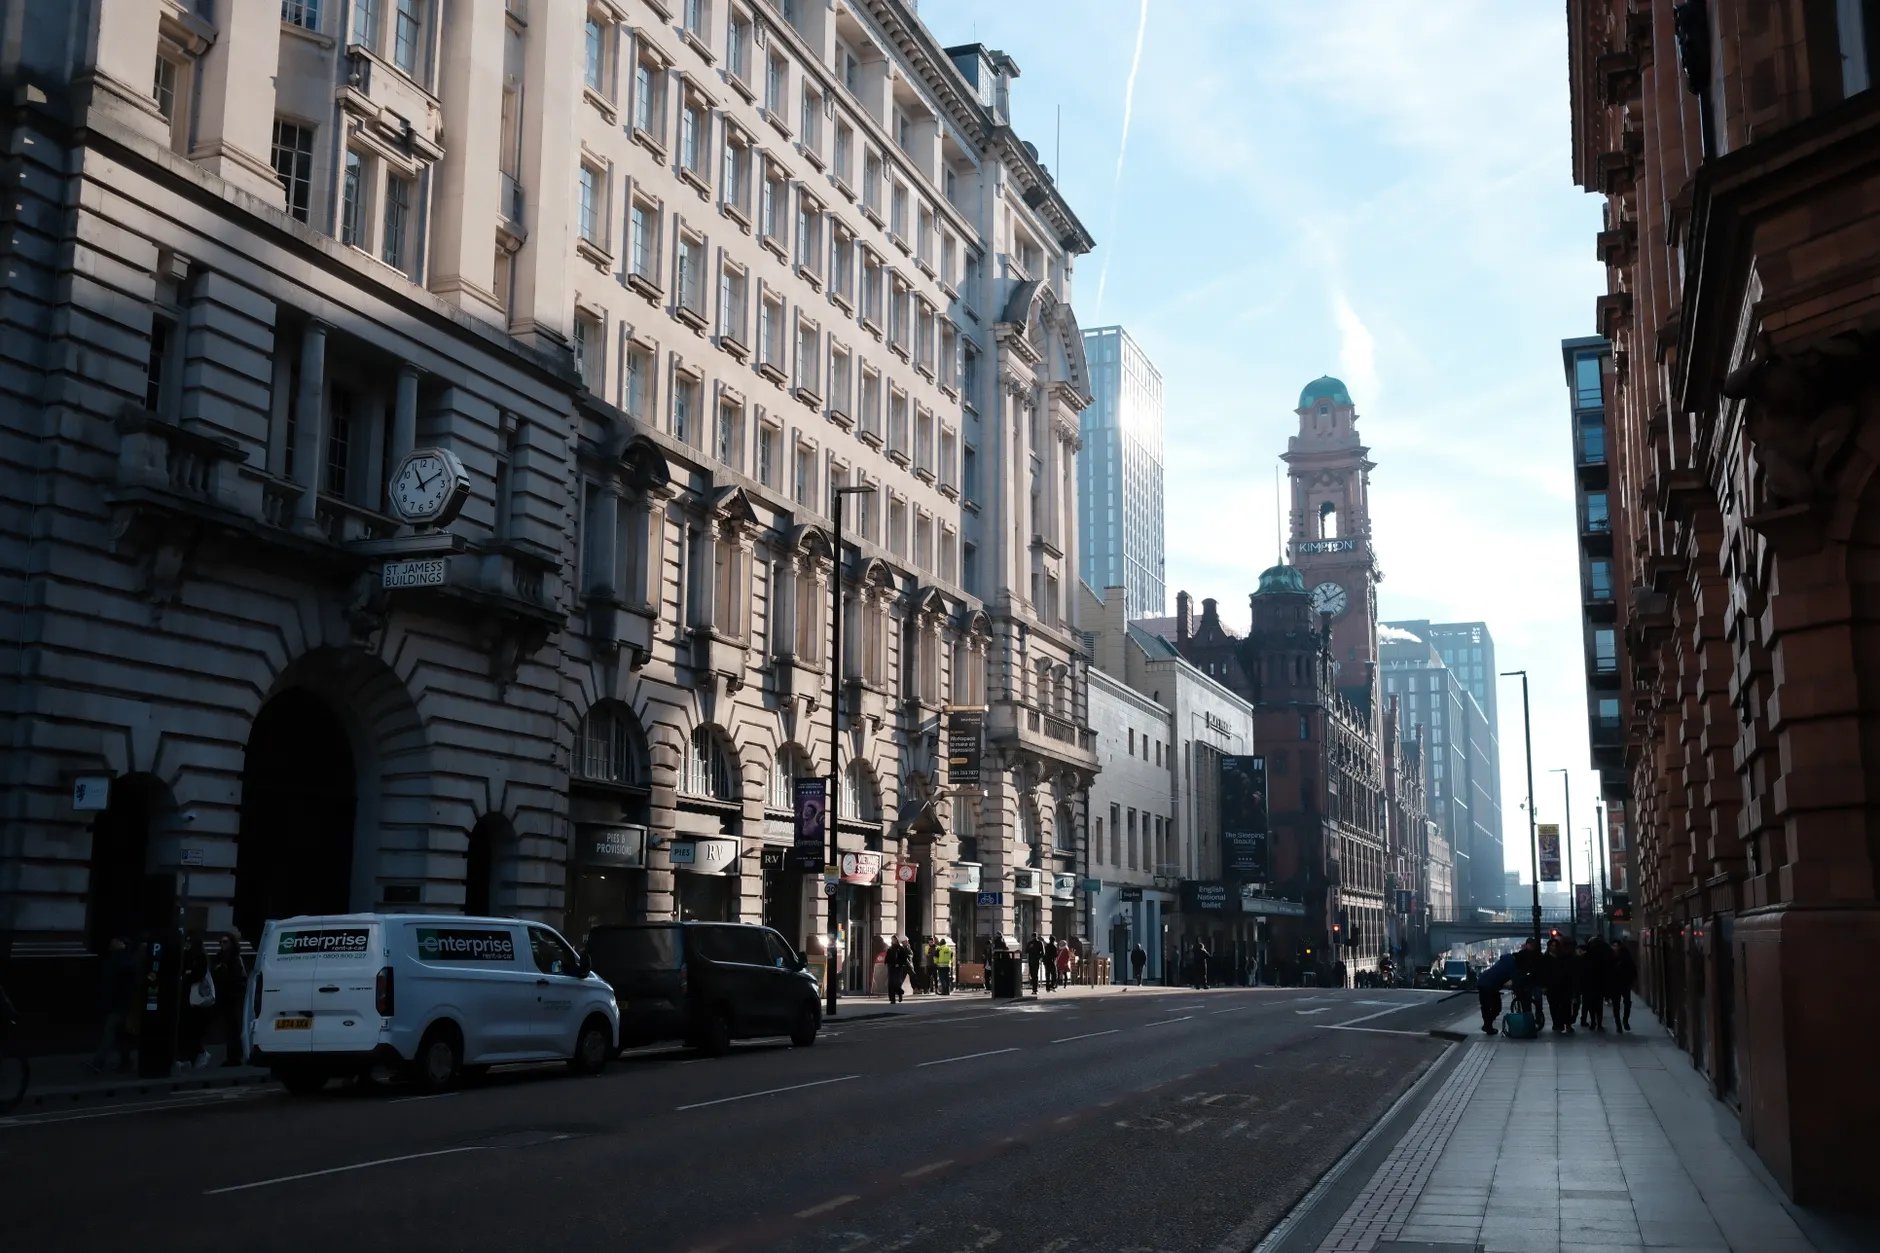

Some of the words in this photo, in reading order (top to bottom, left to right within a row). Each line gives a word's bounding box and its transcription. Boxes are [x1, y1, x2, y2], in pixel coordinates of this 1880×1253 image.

[420, 459, 427, 468] 12
[400, 483, 406, 491] 9
[440, 480, 446, 488] 3
[402, 495, 407, 503] 8
[410, 502, 415, 510] 7
[418, 504, 424, 512] 6
[428, 501, 434, 509] 5
[1299, 540, 1353, 553] KIMPTON
[386, 565, 399, 576] ST.
[385, 572, 442, 586] BUILDINGS
[1390, 659, 1434, 670] VITA
[606, 833, 621, 843] PIES
[596, 843, 632, 856] PROVISIONS
[674, 848, 690, 857] PIES
[706, 844, 723, 861] RV
[826, 885, 836, 893] 20
[1198, 886, 1224, 894] English
[1197, 893, 1226, 901] National
[1201, 901, 1221, 909] Ballet
[280, 932, 367, 949] enterprise
[153, 943, 160, 957] P
[419, 935, 512, 956] enterprise
